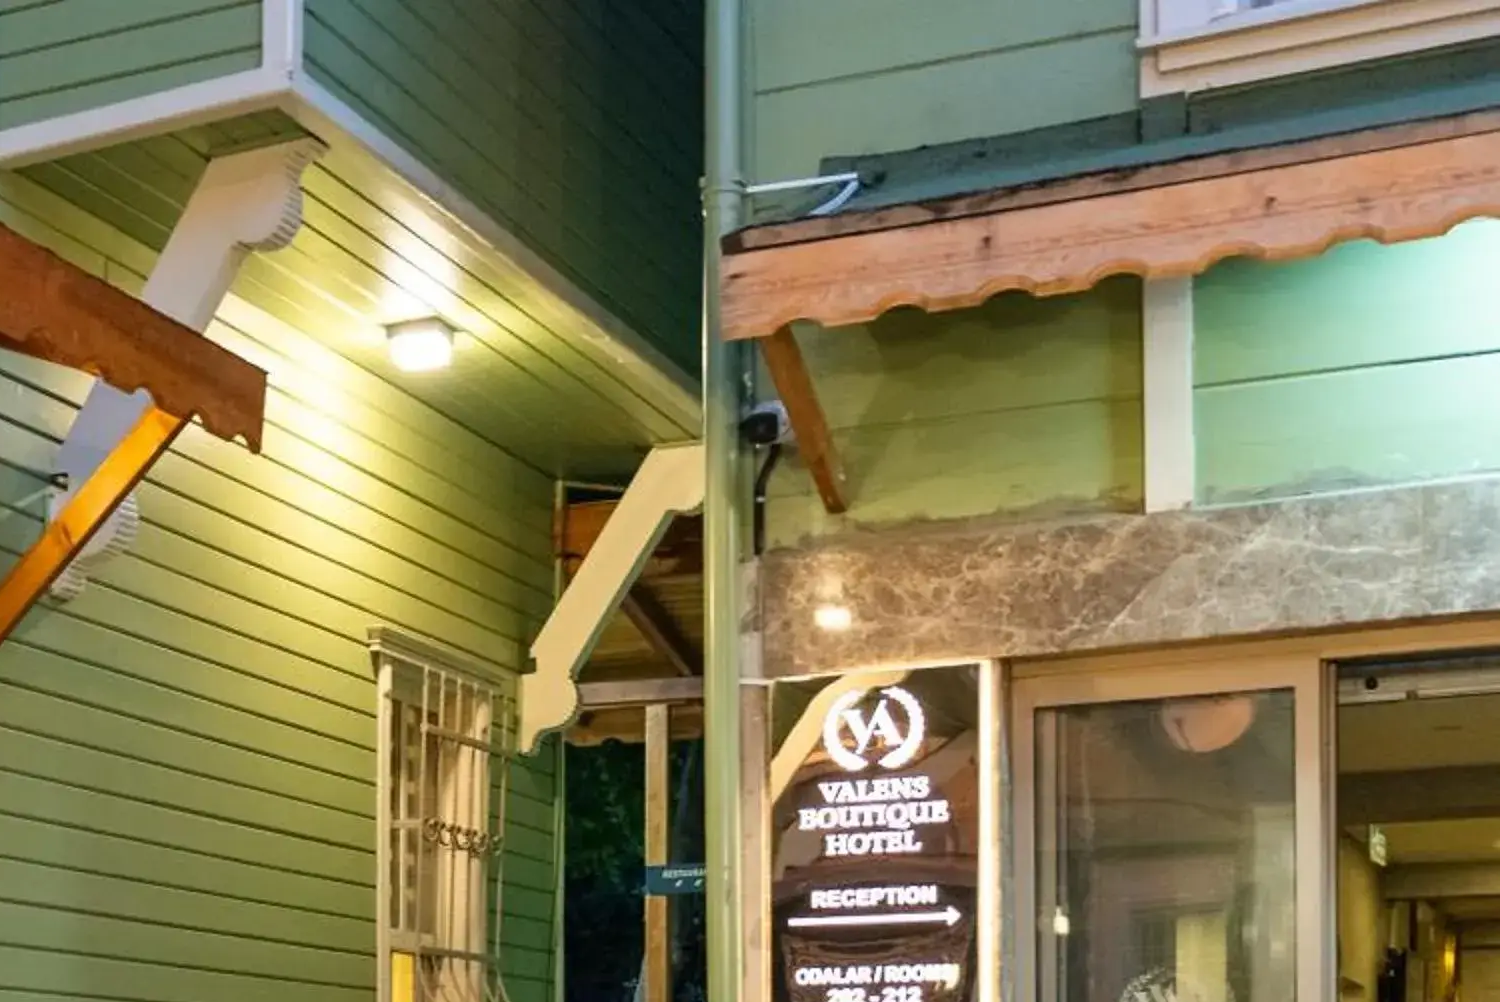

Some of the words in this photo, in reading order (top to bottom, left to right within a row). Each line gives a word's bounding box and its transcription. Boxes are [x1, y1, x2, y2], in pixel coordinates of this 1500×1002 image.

[818, 776, 930, 804] VALENS
[798, 800, 950, 830] BOUTIQUE
[825, 830, 923, 856] HOTEL
[811, 886, 937, 909] RECEPTION
[795, 966, 872, 985] ODALAR
[884, 964, 960, 983] ROOMS
